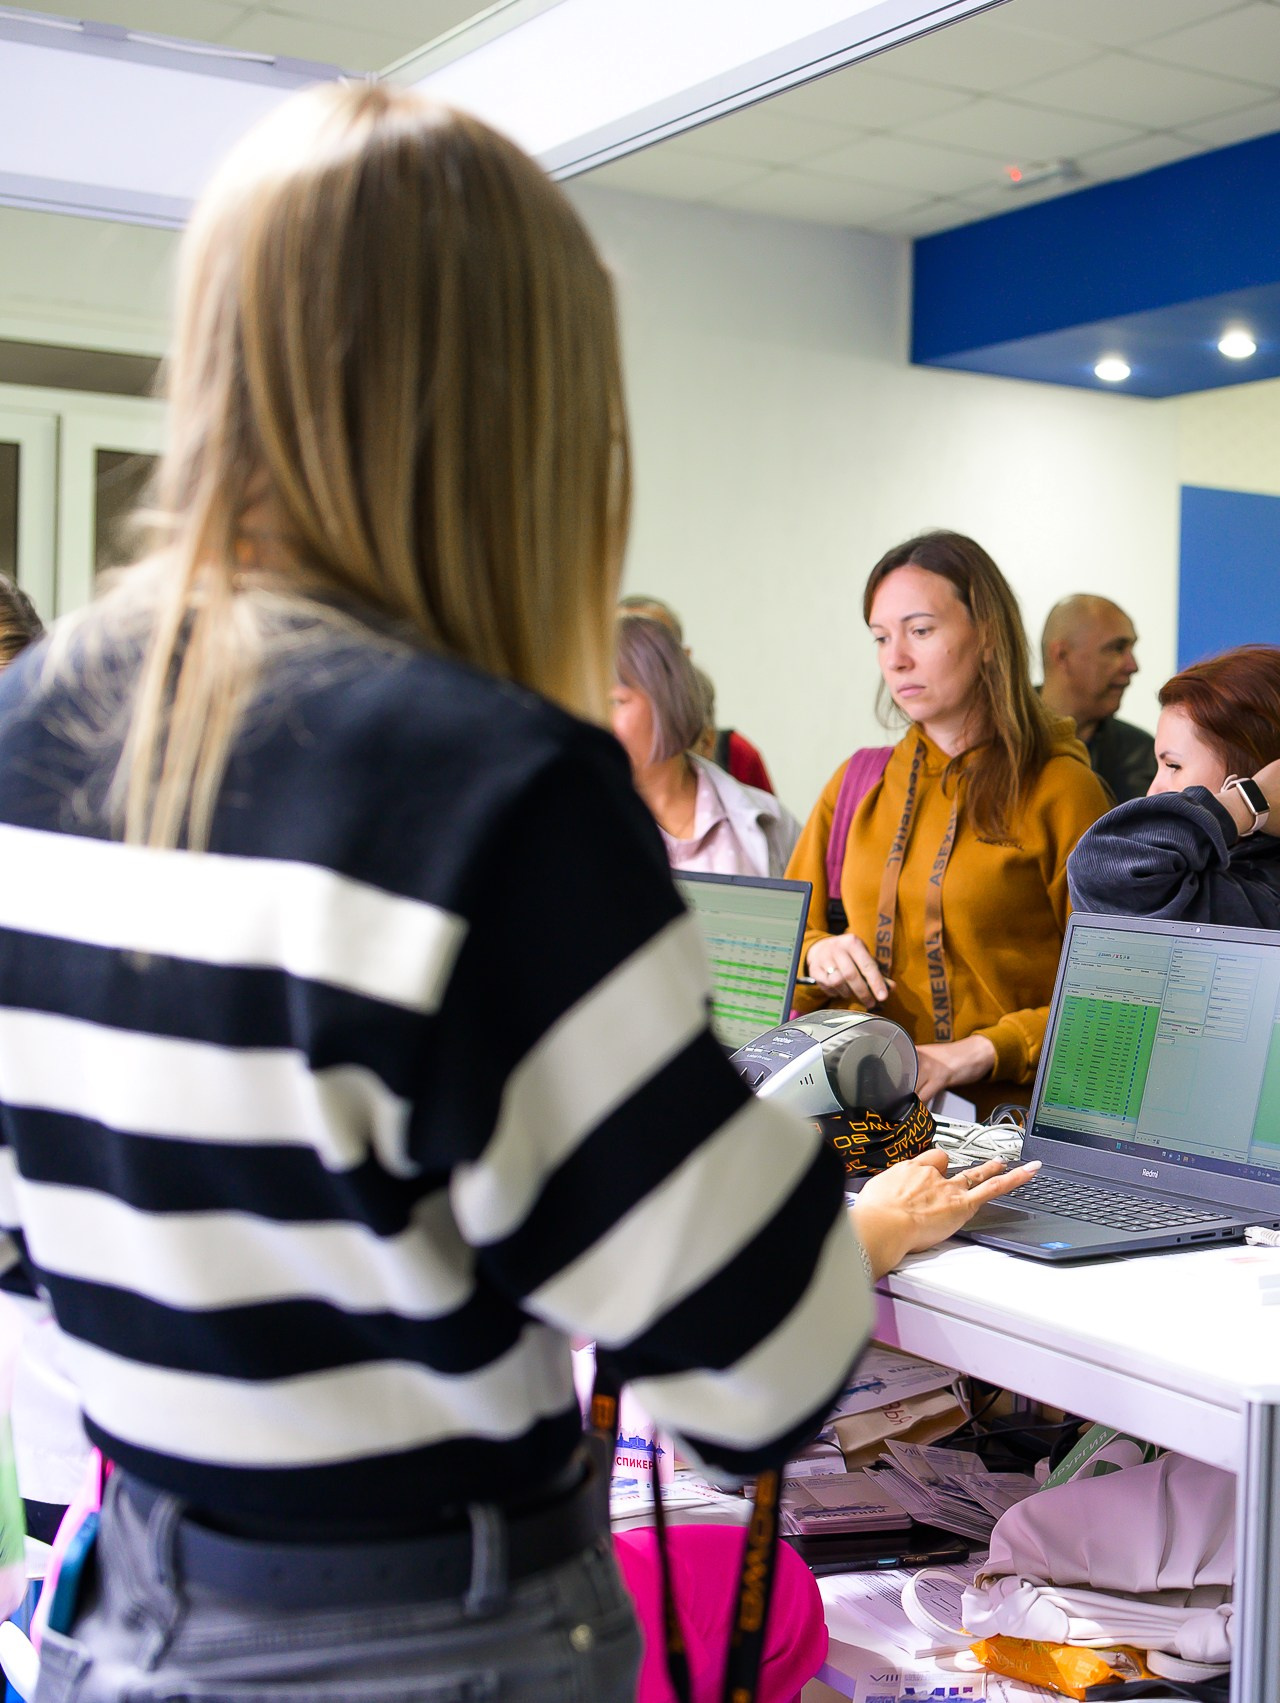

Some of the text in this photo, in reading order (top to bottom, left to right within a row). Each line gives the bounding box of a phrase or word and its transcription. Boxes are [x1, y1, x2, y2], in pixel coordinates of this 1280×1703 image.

[1141, 1168, 1159, 1179] Redmi
[615, 1456, 654, 1470] СПИКЕР
[869, 1674, 899, 1683] VIII
